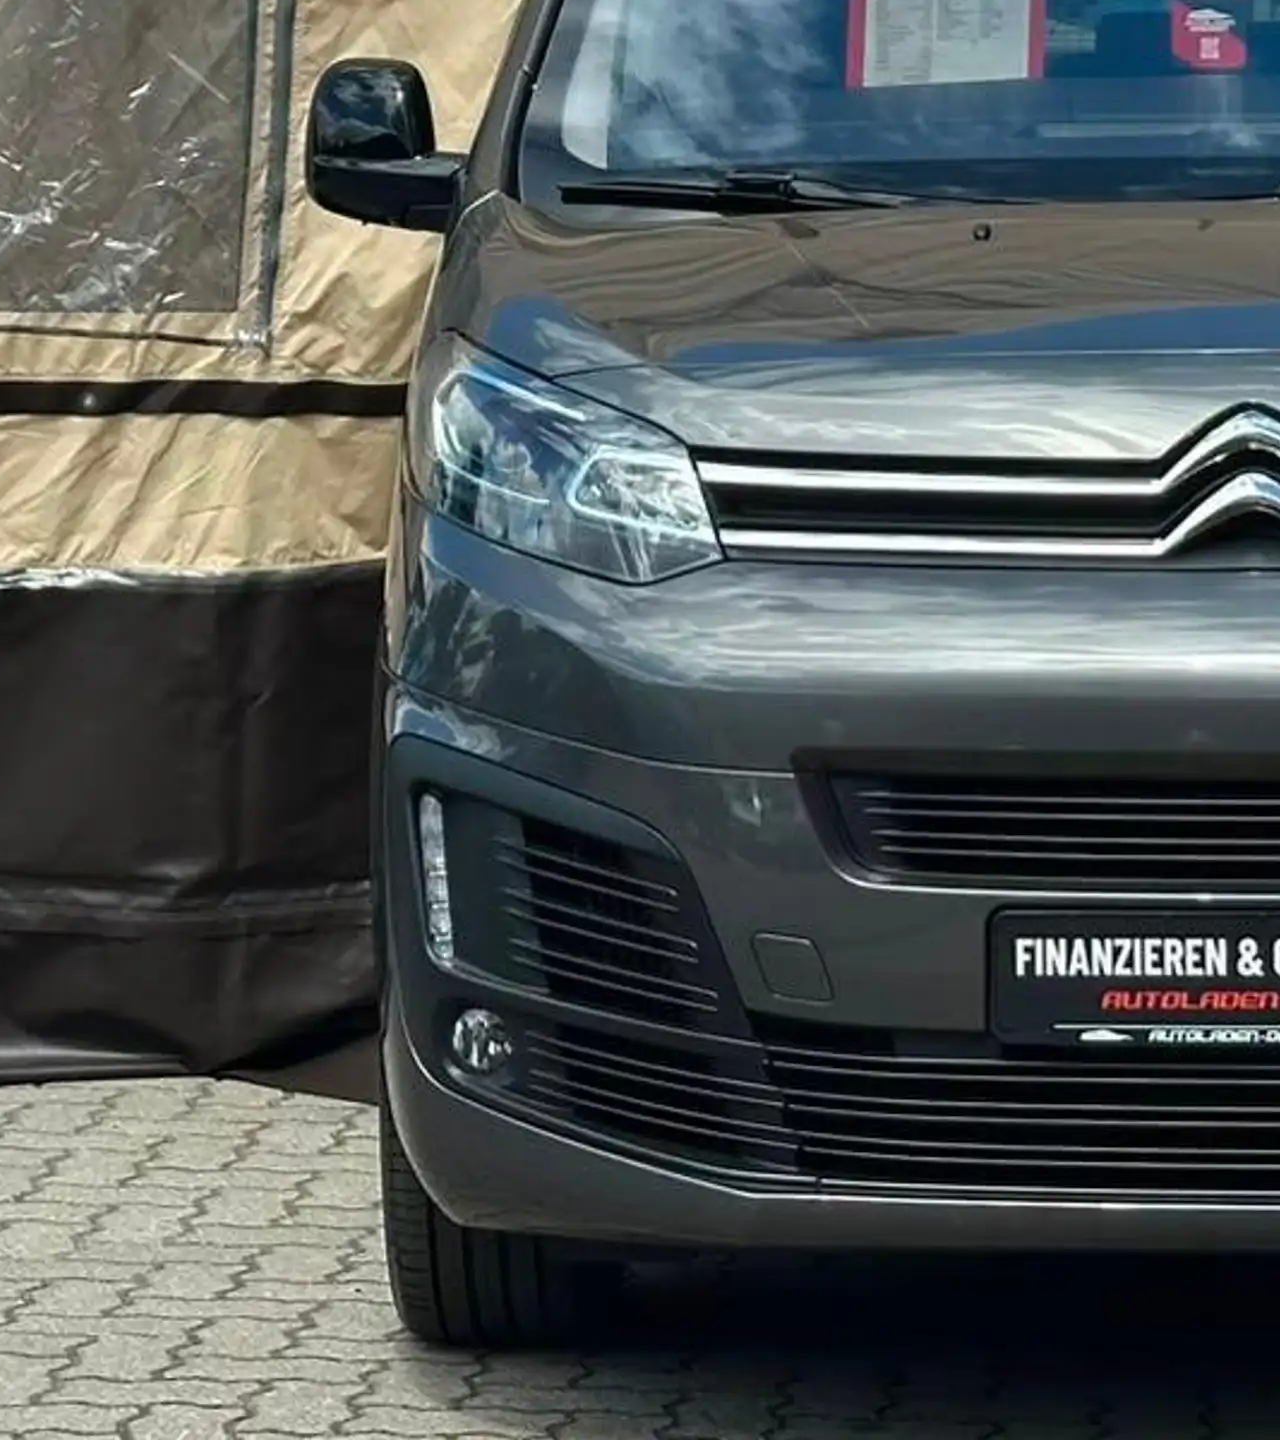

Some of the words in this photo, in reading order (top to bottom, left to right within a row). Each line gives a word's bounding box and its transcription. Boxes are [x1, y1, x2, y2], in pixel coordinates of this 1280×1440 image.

[1015, 937, 1228, 977] FINANZIEREN
[1236, 936, 1265, 977] &
[1101, 990, 1280, 1010] AUTOLADEN
